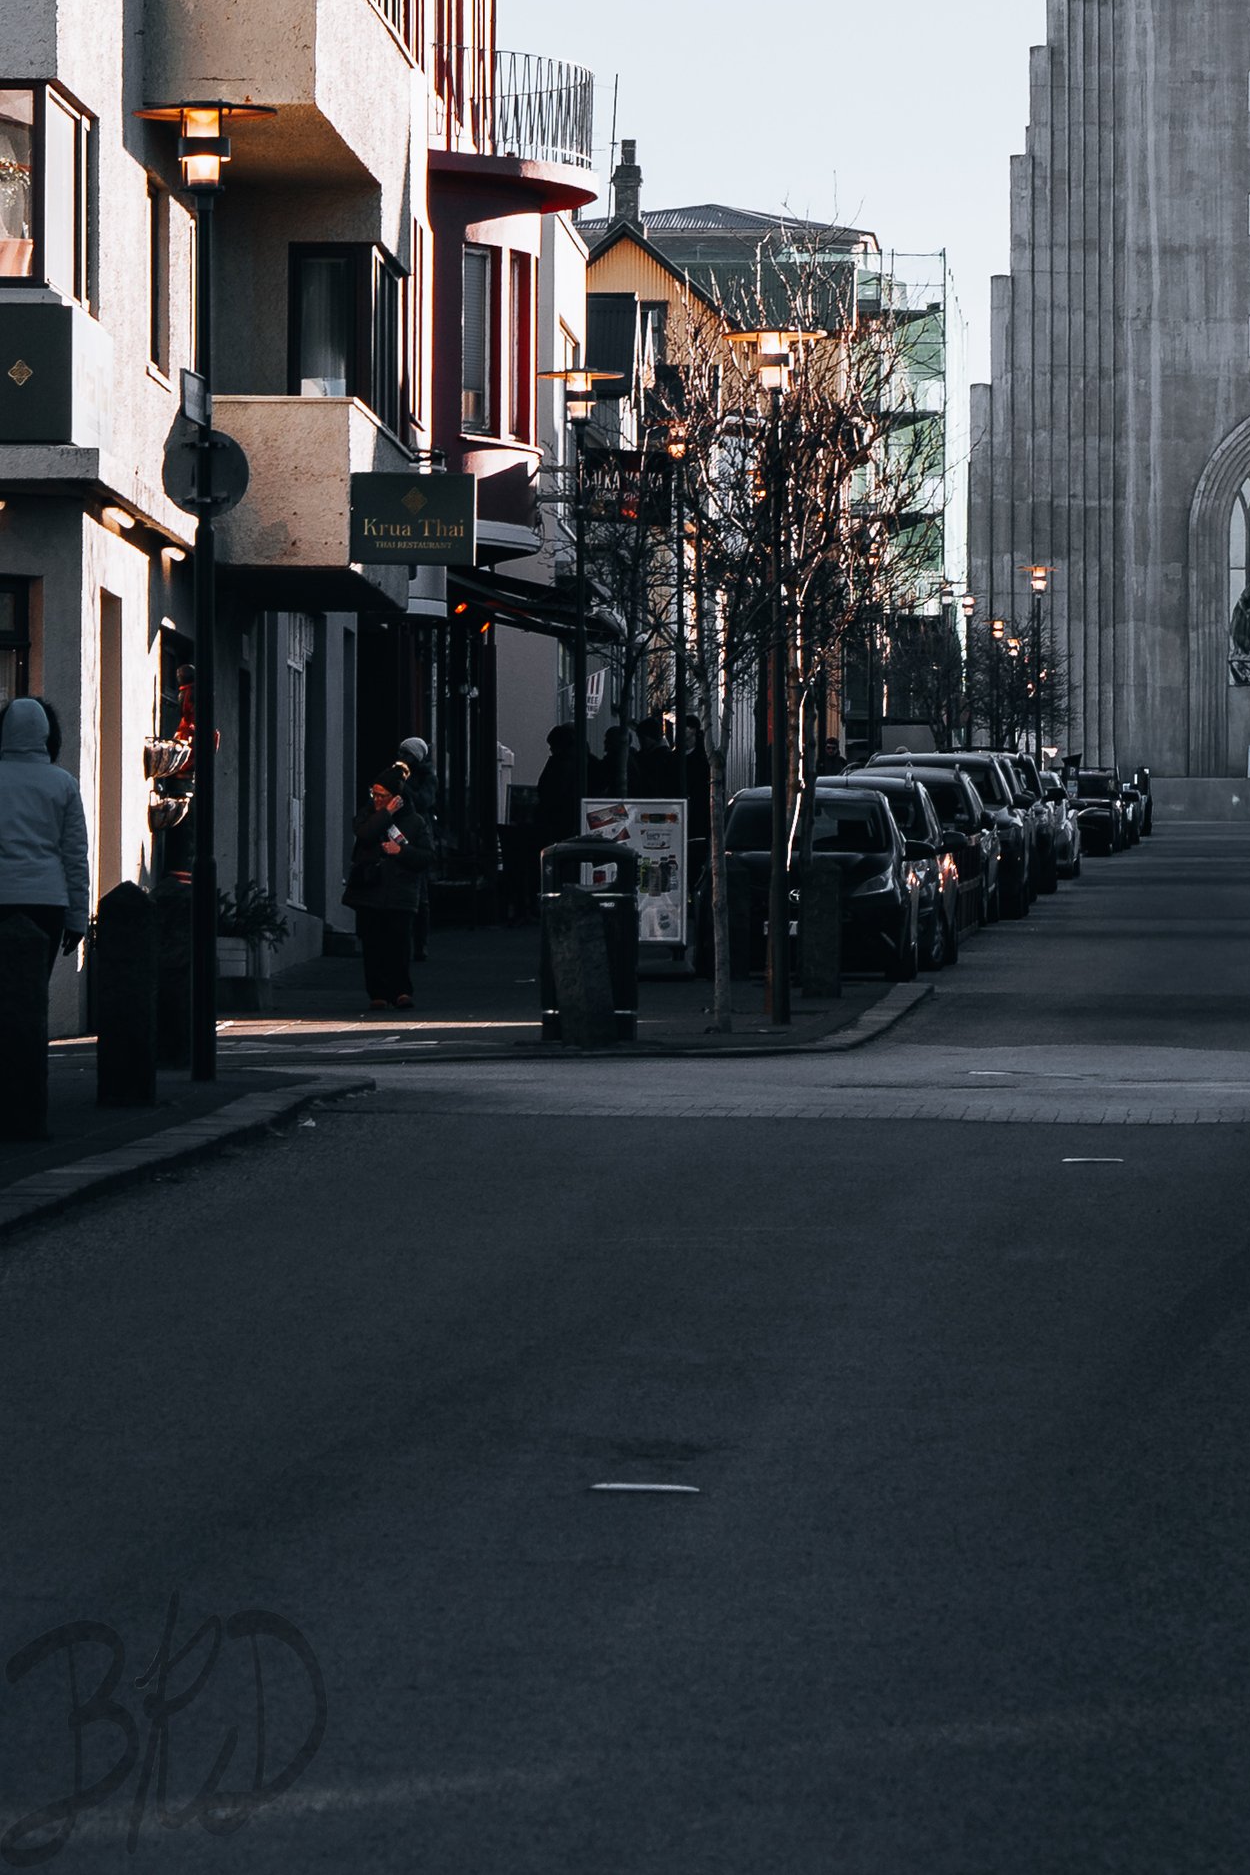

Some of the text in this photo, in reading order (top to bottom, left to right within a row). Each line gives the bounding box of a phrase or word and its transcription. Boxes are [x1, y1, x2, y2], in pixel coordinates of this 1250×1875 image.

[363, 517, 465, 537] Krua Thai
[375, 540, 453, 549] THAI RESTAURANT
